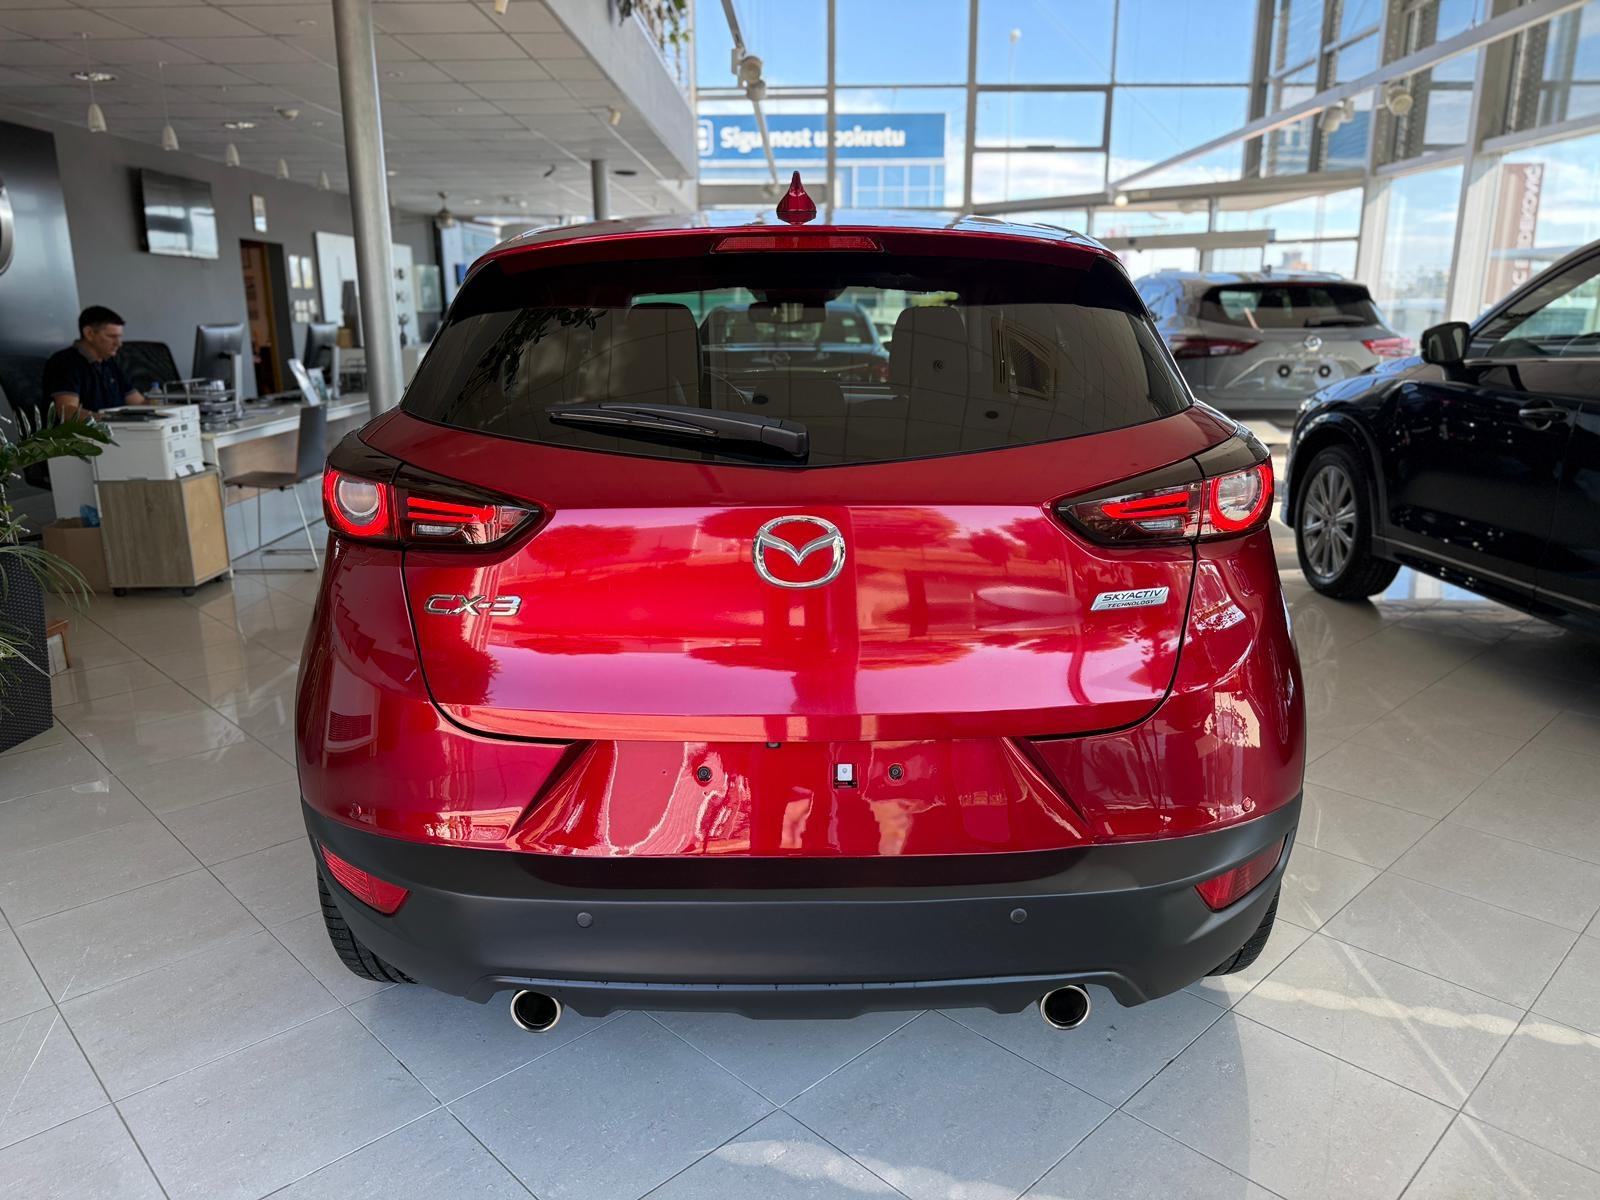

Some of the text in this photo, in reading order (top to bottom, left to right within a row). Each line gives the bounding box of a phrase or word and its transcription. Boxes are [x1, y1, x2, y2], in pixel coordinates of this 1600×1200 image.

[720, 127, 812, 153] Sigunost
[1102, 589, 1163, 602] SKYACTIV
[1107, 599, 1156, 608] TECHNOLOGY
[424, 594, 522, 616] CX-3
